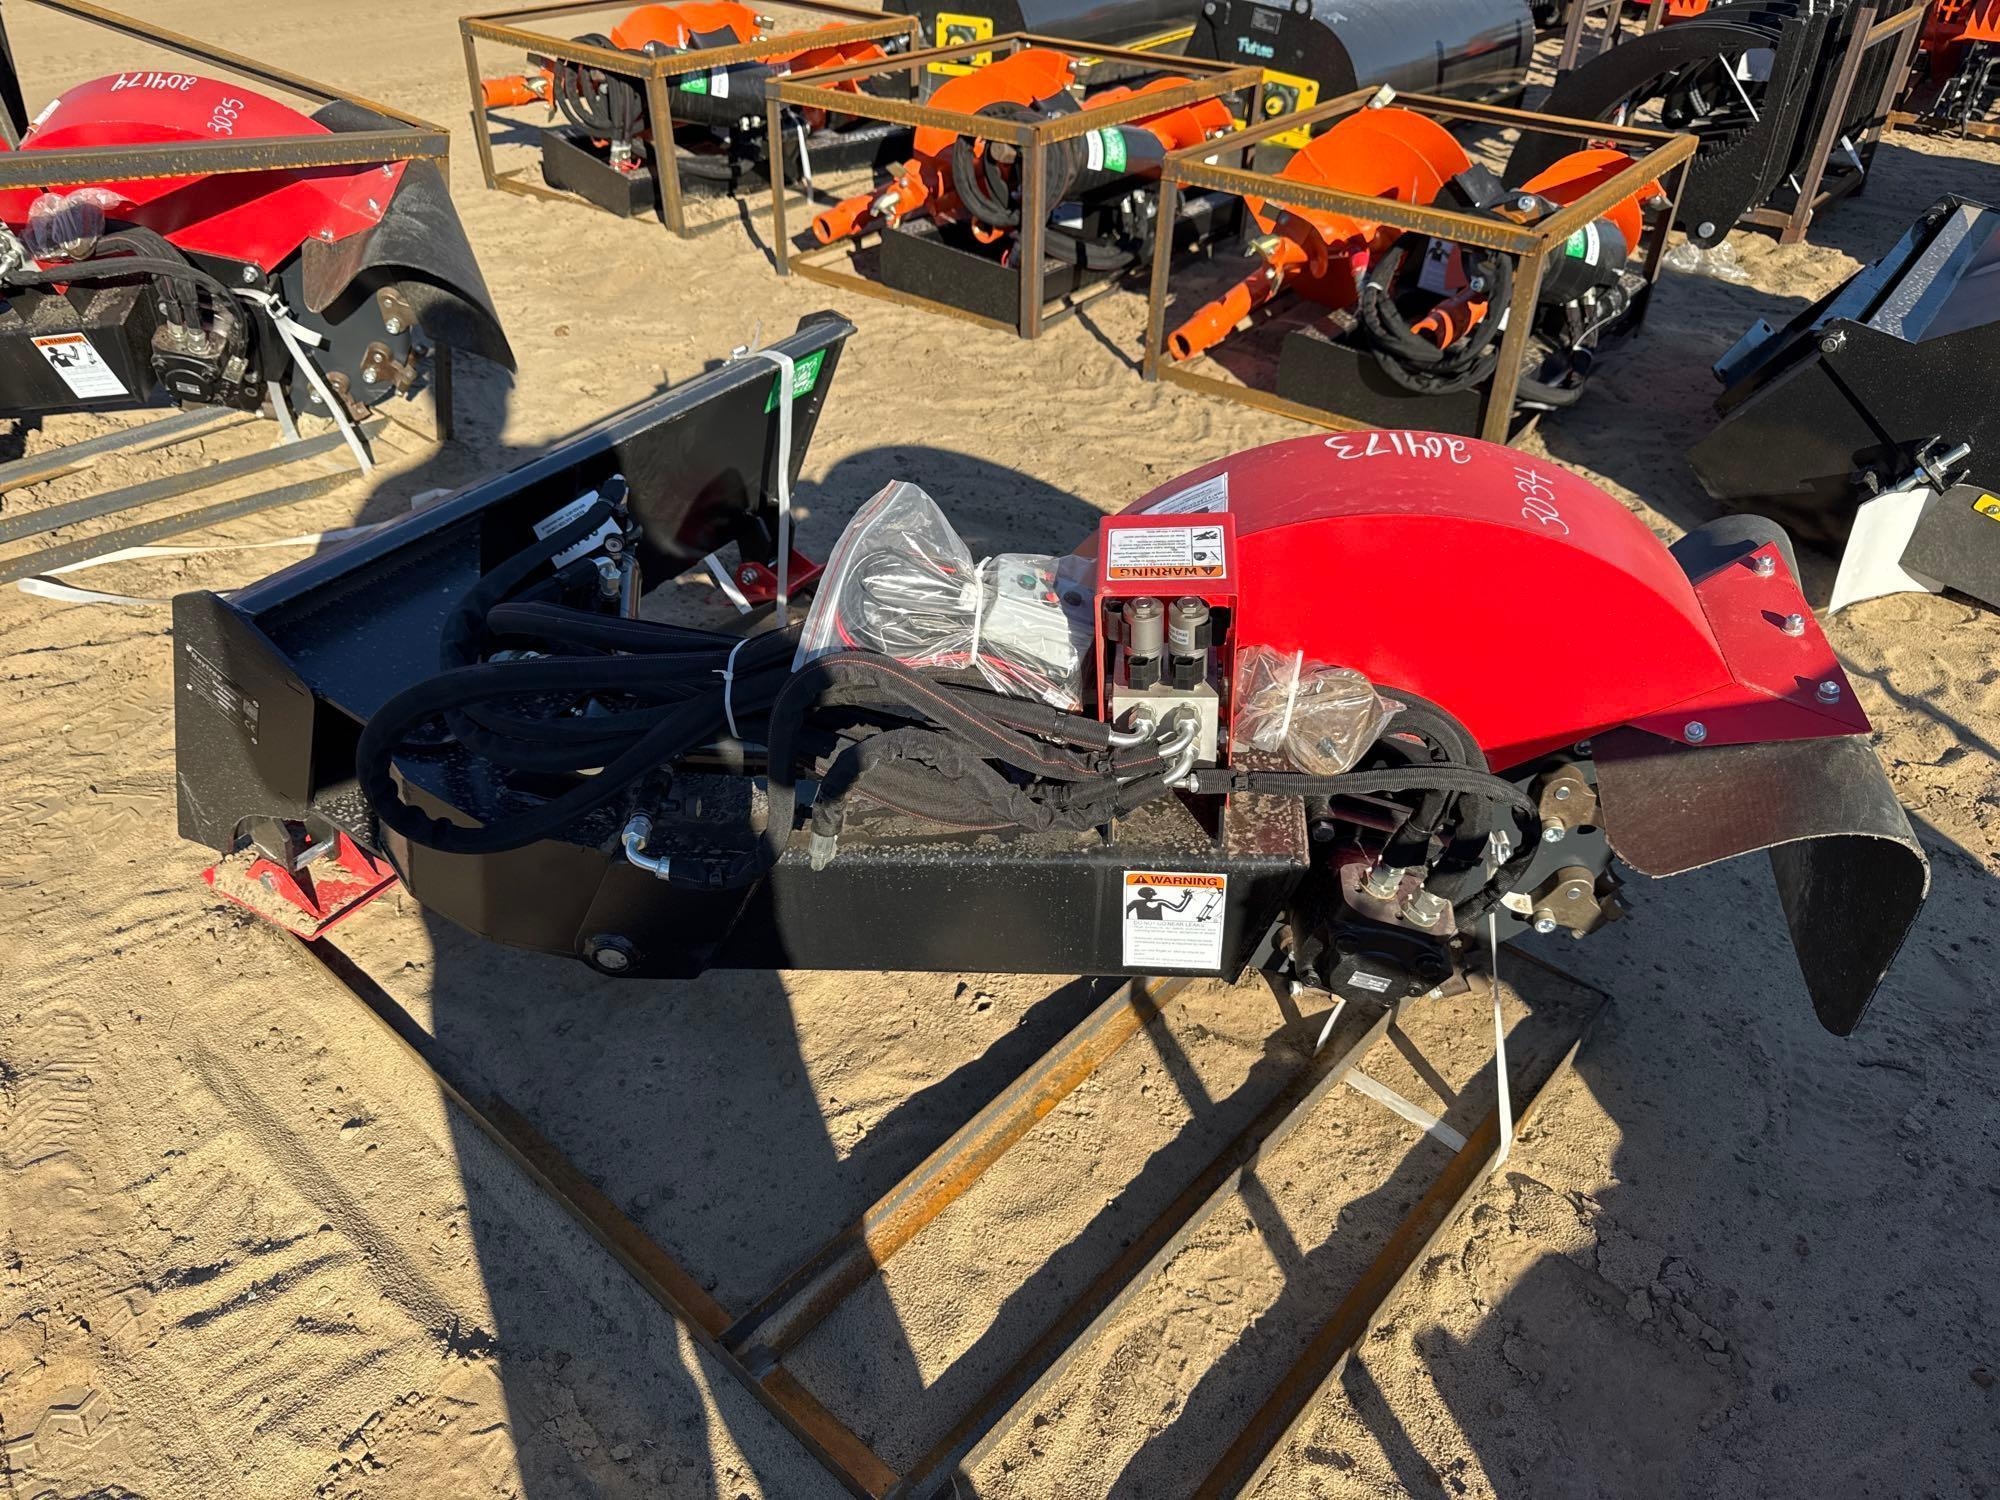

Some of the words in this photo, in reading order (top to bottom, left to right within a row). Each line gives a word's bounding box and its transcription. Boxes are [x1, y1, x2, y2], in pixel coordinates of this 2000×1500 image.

[110, 72, 198, 92] 204174
[206, 97, 245, 136] 3035
[1324, 431, 1472, 464] 204173
[1513, 467, 1570, 535] 3034
[1120, 567, 1197, 577] WARNING
[1150, 875, 1218, 886] WARNING
